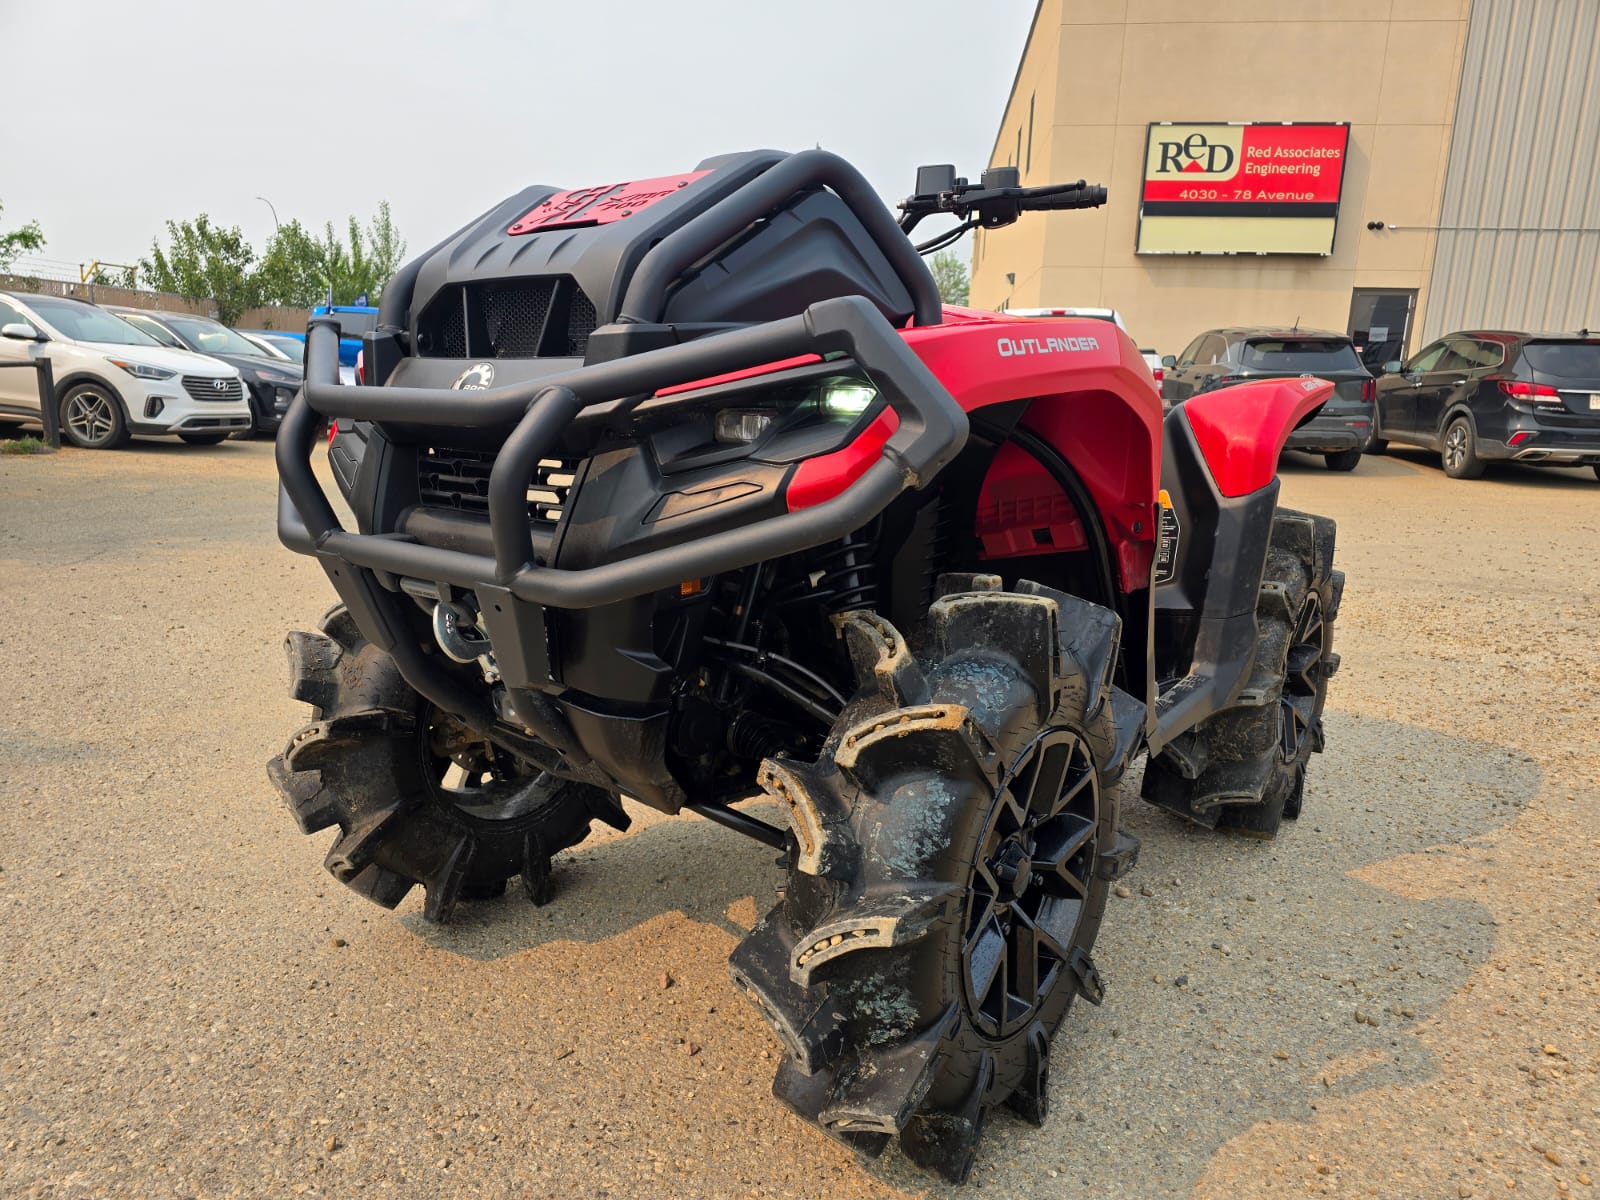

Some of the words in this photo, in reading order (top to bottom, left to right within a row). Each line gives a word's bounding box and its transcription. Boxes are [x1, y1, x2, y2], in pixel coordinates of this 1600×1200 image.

[1247, 146, 1272, 158] Red
[1274, 146, 1340, 158] Associates
[1245, 162, 1321, 177] Engineering
[1179, 190, 1217, 200] 4030
[1233, 190, 1252, 200] 78
[1256, 190, 1314, 200] Avenue
[997, 337, 1100, 357] OUTLANDER
